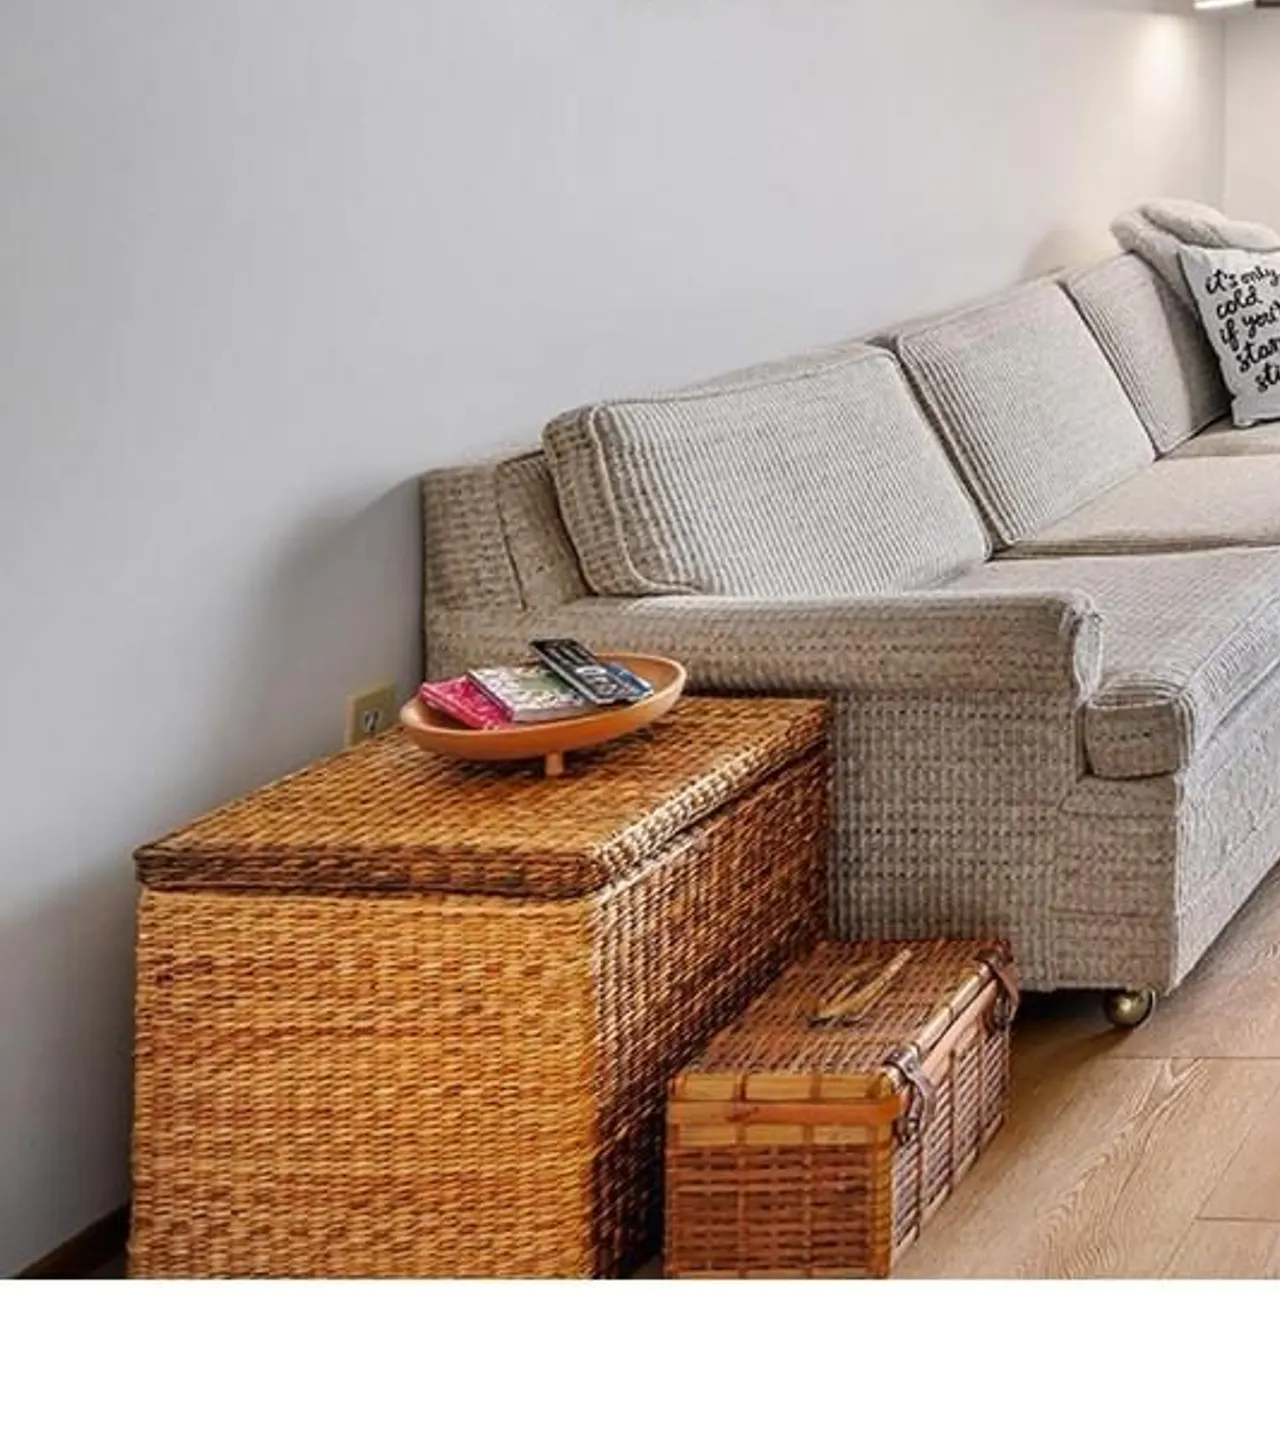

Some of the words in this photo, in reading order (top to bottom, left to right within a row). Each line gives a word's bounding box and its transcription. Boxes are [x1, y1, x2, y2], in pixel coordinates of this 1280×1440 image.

[1205, 269, 1238, 294] it's
[1241, 265, 1280, 286] only
[1216, 285, 1263, 319] cold
[1219, 318, 1239, 351] if
